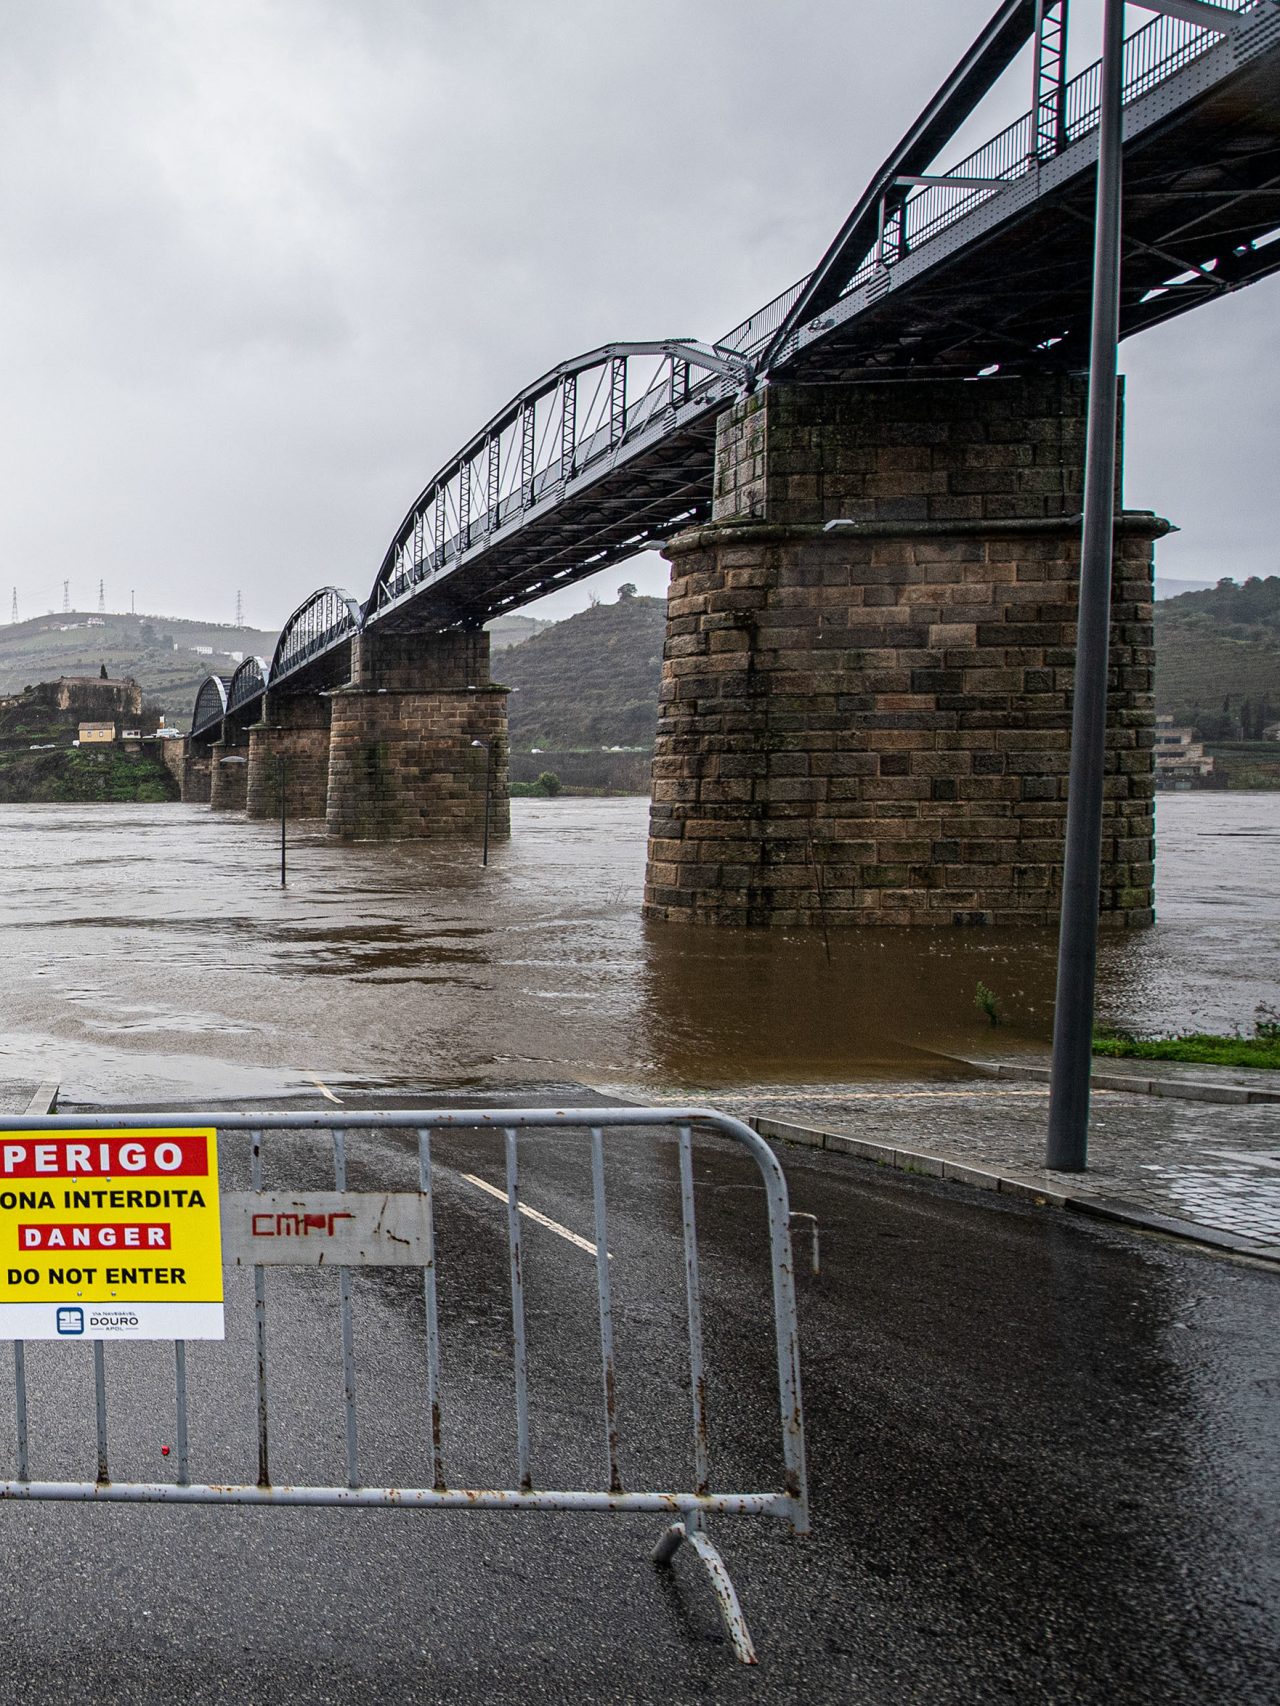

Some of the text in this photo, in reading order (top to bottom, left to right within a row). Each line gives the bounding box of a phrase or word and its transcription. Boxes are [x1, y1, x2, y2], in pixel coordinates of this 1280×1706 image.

[3, 1142, 183, 1173] PERIGO
[64, 1190, 206, 1209] INTERDITA
[24, 1227, 166, 1247] DANGER
[7, 1267, 187, 1285] DO NOT ENTER
[90, 1317, 138, 1325] DOURO
